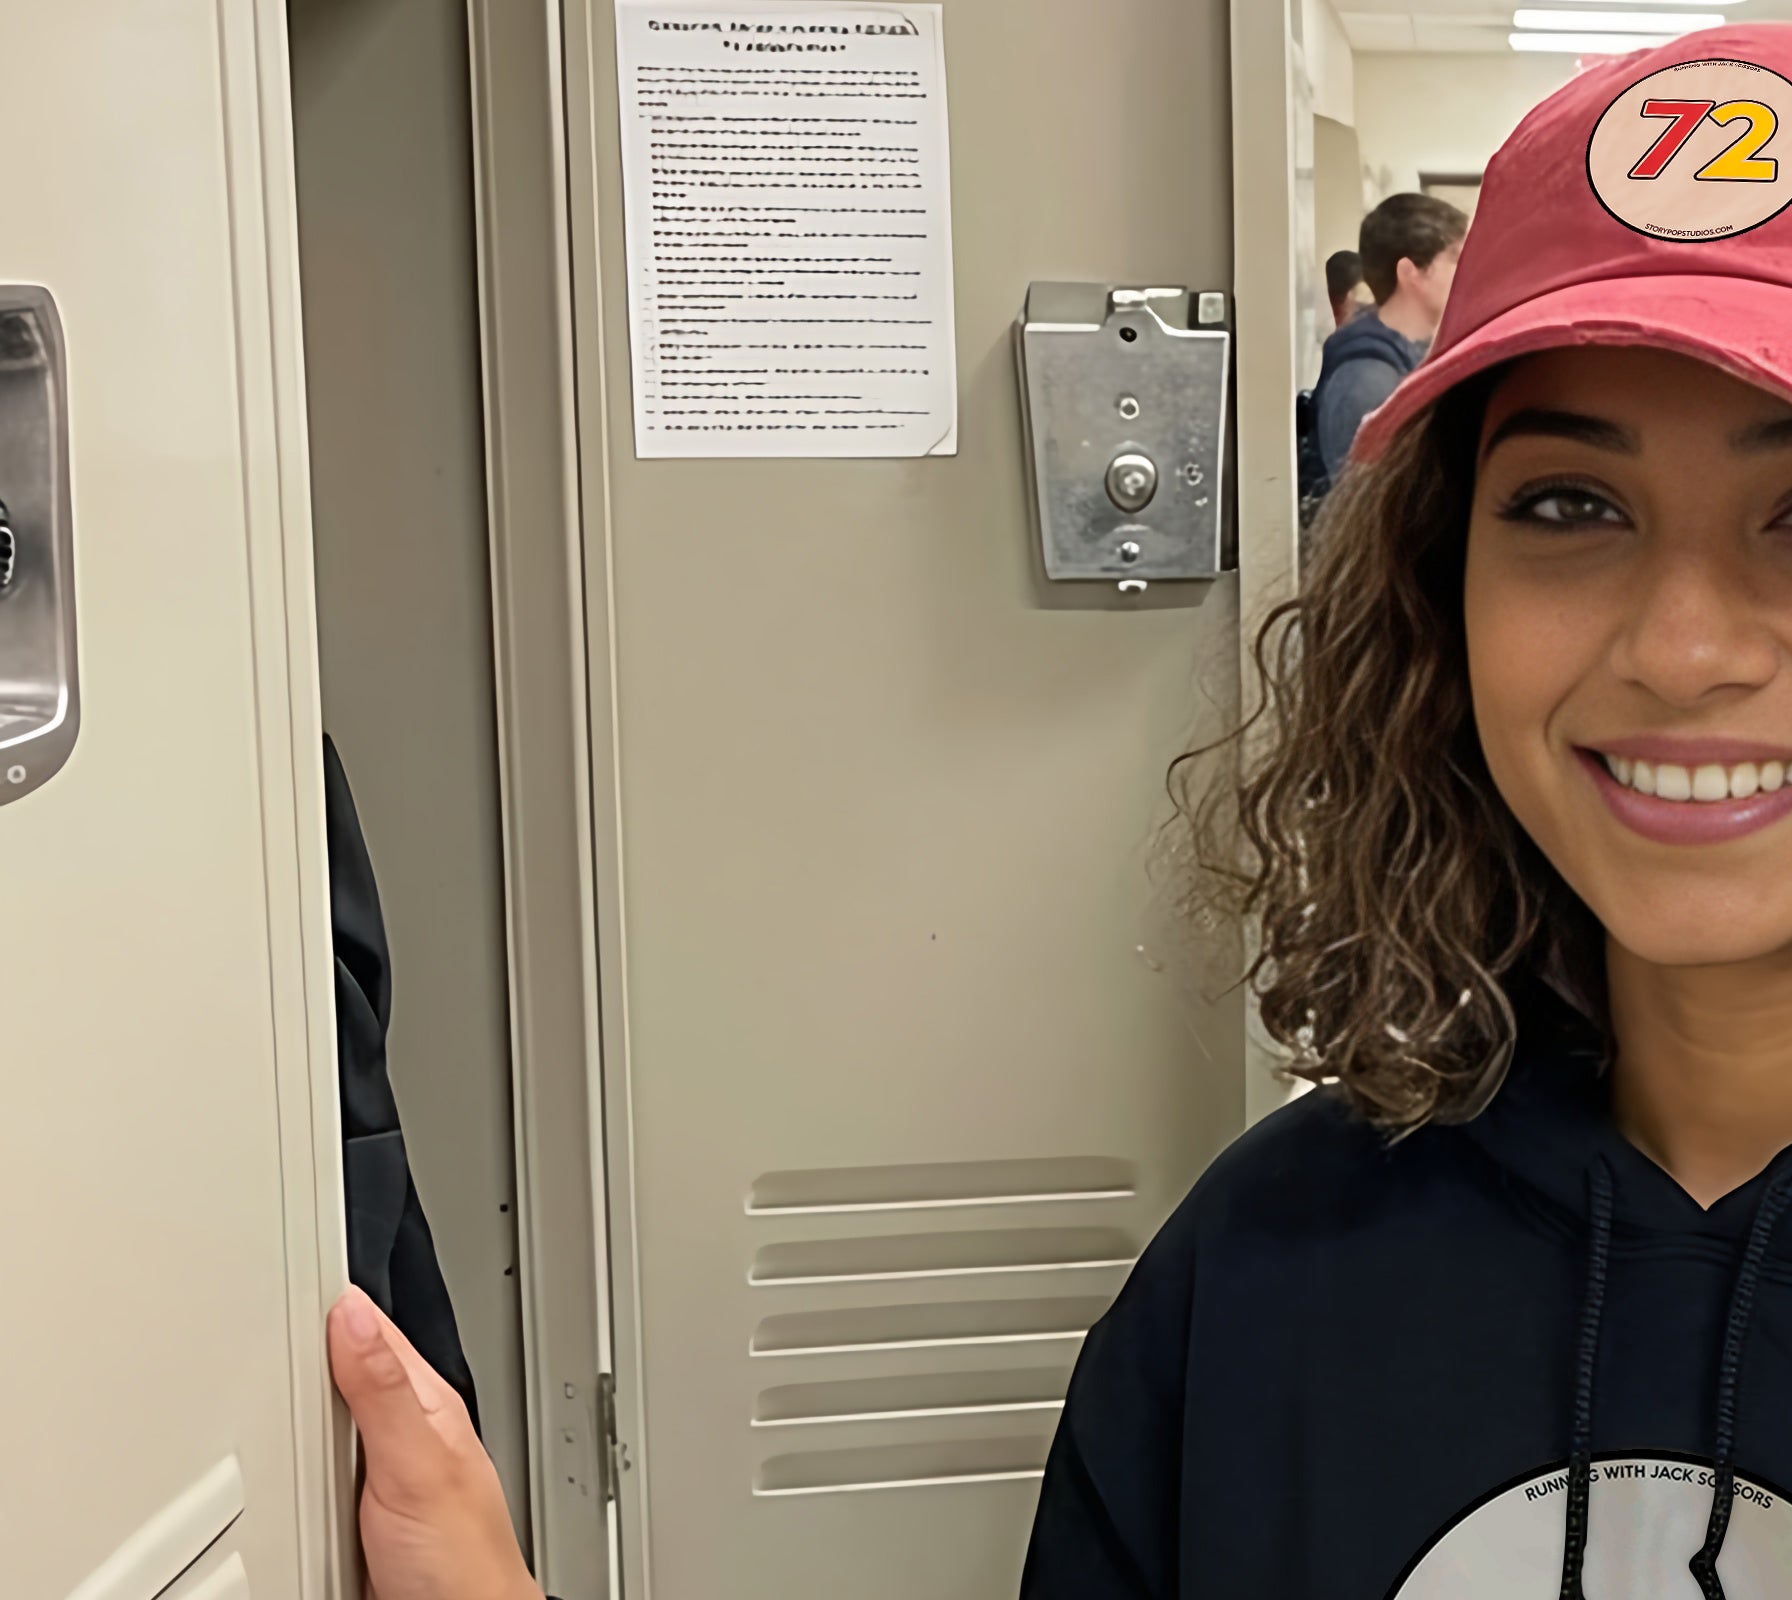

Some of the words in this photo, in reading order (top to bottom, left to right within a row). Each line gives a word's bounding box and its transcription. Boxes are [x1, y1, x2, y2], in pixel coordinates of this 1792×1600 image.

[1628, 100, 1778, 182] 72
[1644, 223, 1734, 237] STORYPOPSTUDIOS.COM
[1525, 1467, 1600, 1502] RUNNG
[1603, 1465, 1646, 1480] WITH
[1650, 1465, 1694, 1483] JACK
[1697, 1471, 1774, 1509] SCSORS
